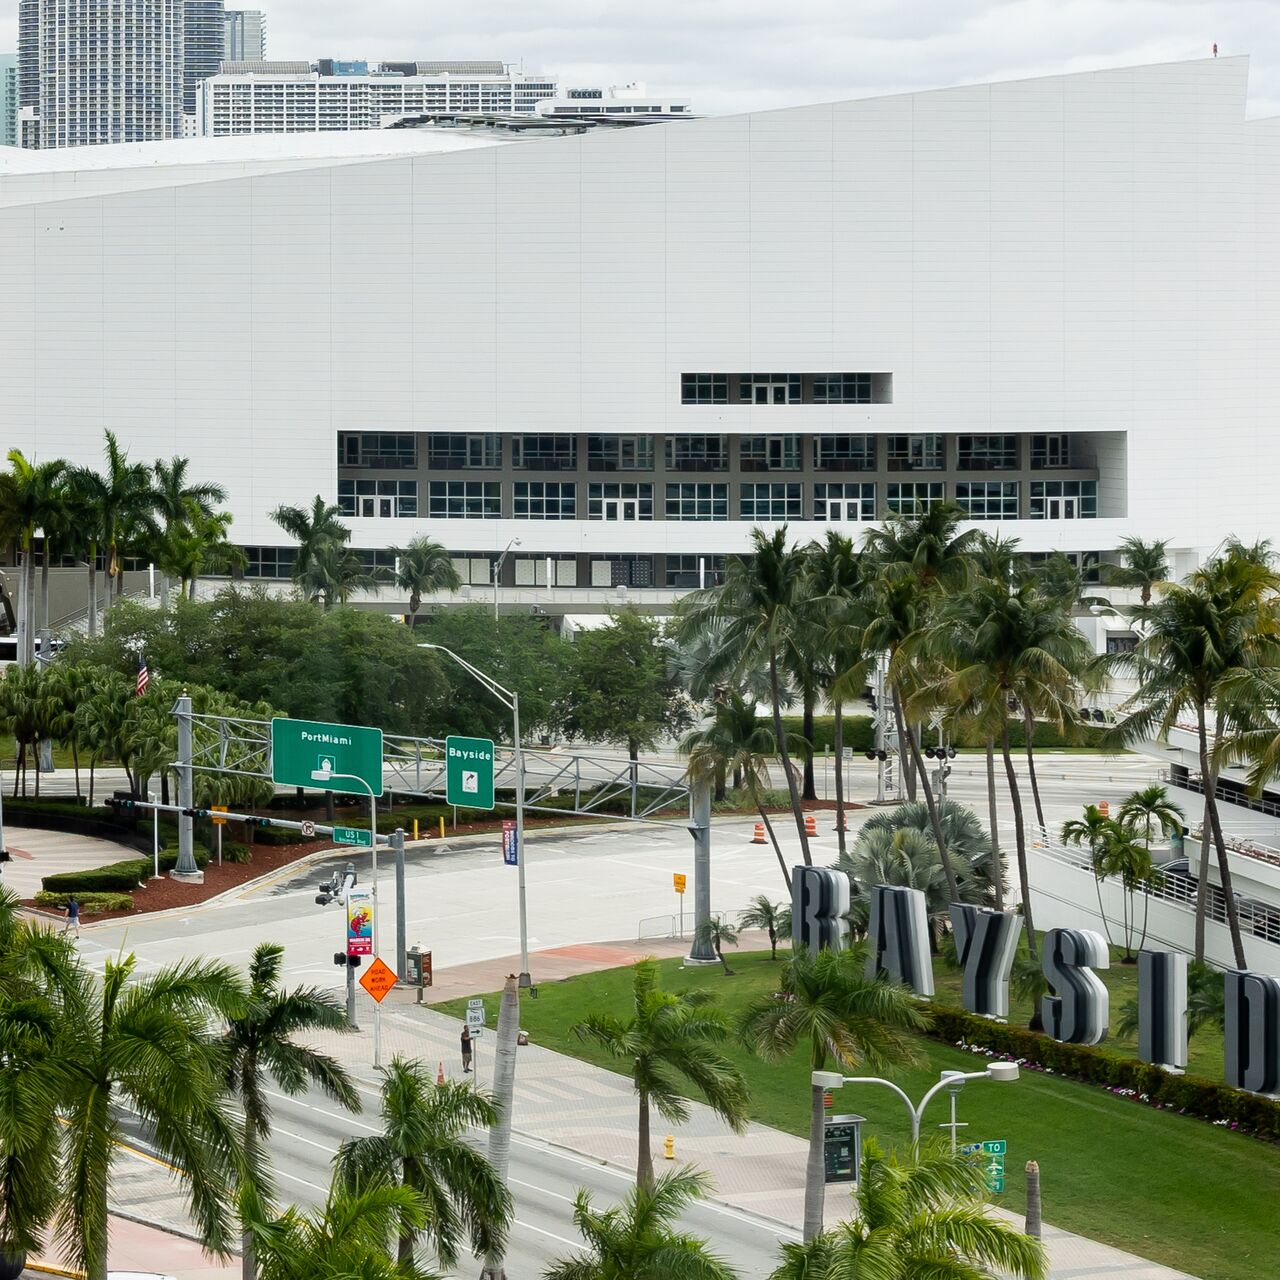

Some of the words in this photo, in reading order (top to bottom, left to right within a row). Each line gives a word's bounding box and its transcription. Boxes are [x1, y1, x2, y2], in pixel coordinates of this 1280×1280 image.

[301, 731, 352, 746] PortMiami
[448, 747, 491, 761] Bayside
[345, 830, 355, 839] US
